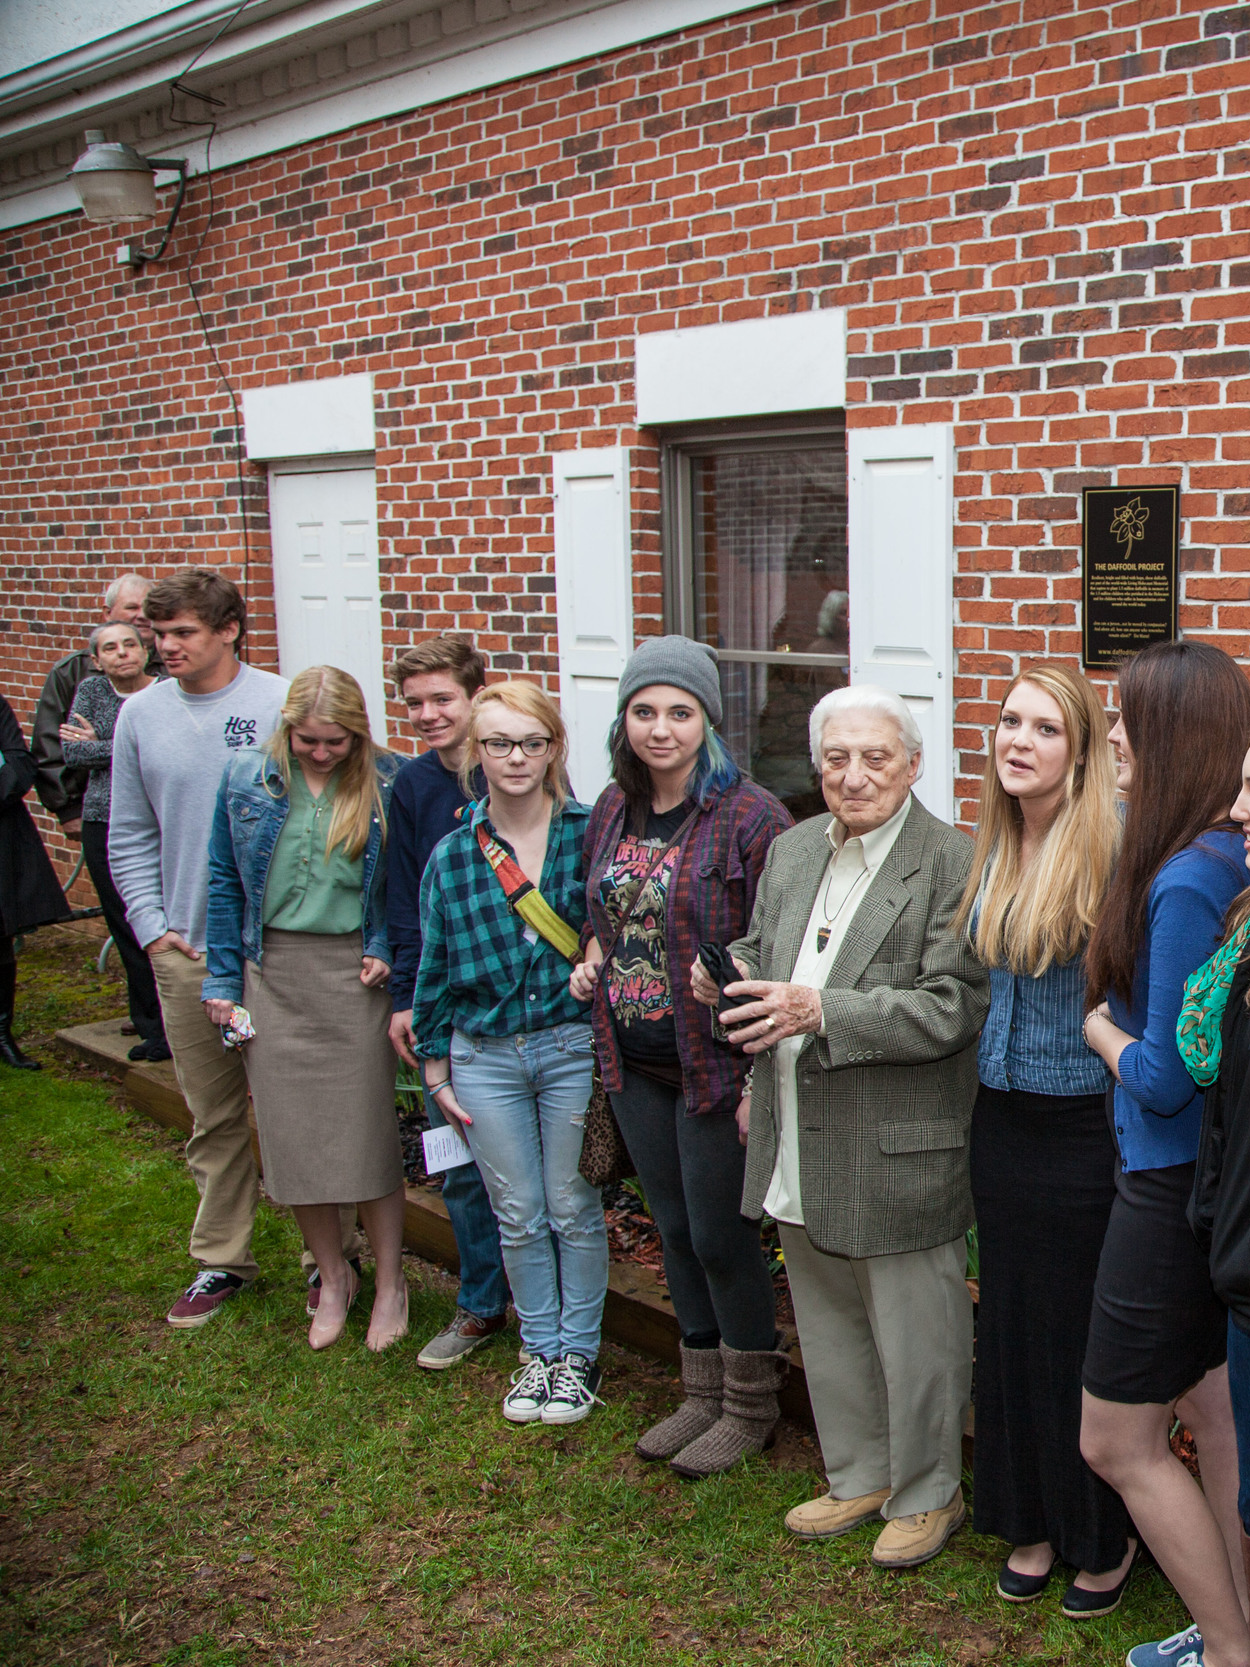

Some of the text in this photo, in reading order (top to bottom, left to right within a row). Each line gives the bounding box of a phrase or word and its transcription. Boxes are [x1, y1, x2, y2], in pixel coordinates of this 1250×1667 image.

[1094, 562, 1164, 570] THE DAFFODIL PROJECT
[626, 834, 638, 844] THE
[615, 842, 649, 862] DEVIL
